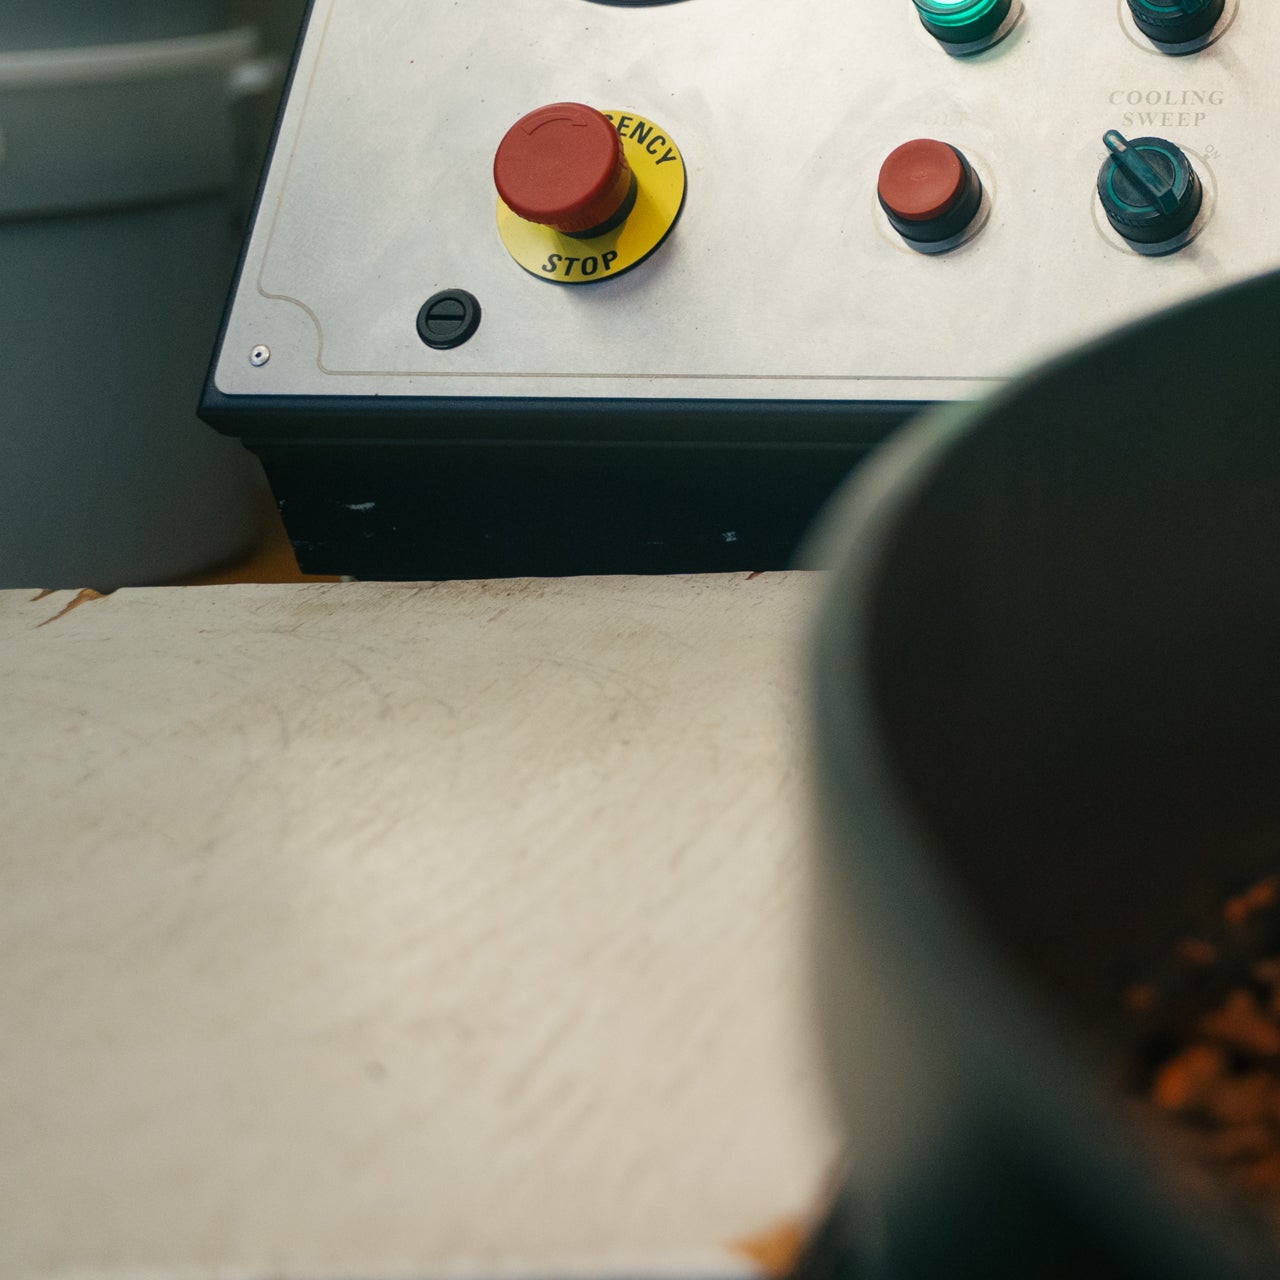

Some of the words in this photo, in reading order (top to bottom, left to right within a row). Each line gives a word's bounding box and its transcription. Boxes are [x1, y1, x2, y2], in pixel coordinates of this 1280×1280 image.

[1108, 89, 1224, 106] COOLING
[1122, 111, 1206, 127] SWEEP
[603, 114, 677, 165] ENCY
[541, 250, 618, 277] STOP
